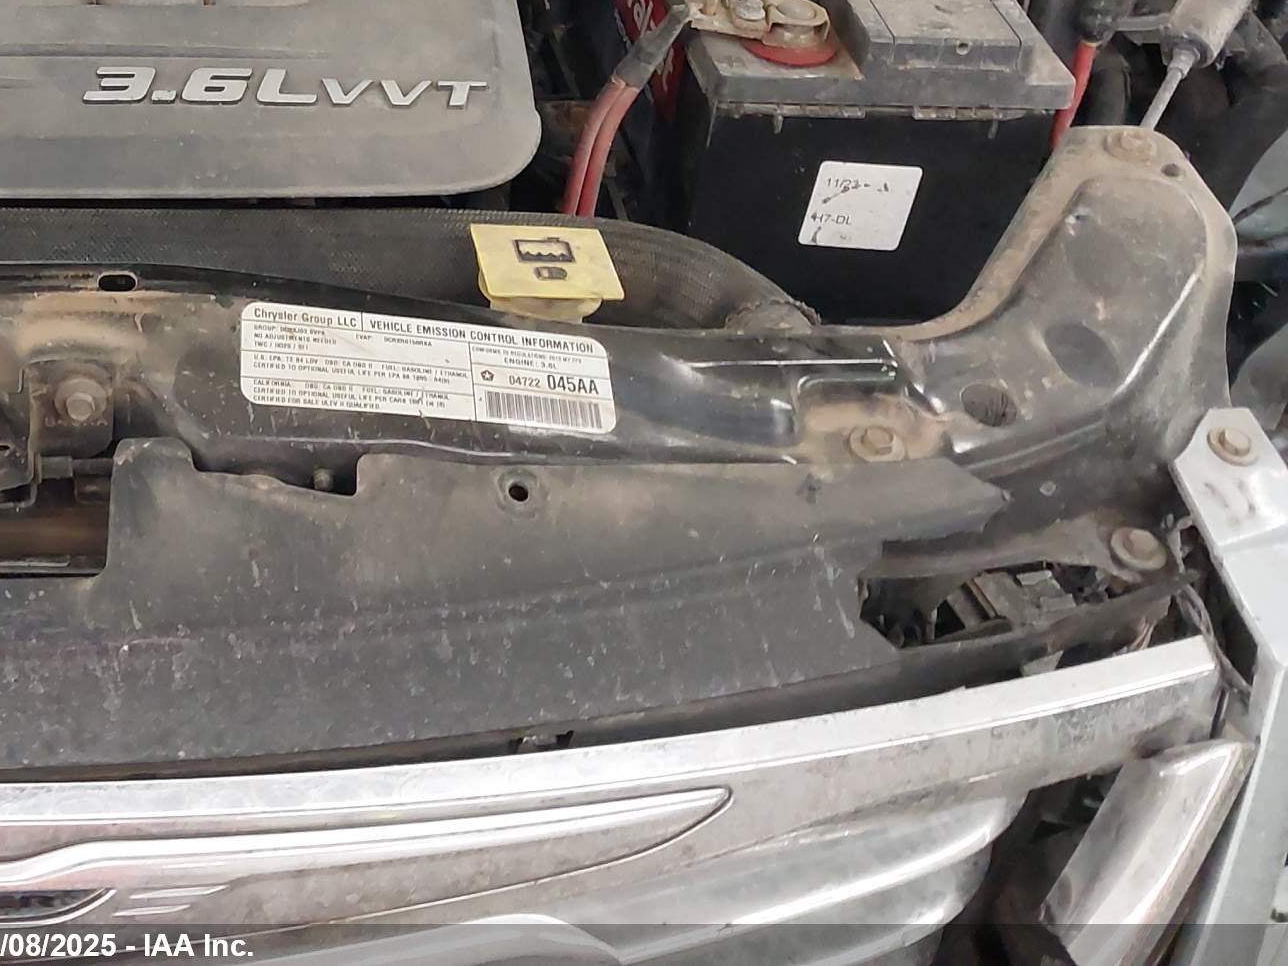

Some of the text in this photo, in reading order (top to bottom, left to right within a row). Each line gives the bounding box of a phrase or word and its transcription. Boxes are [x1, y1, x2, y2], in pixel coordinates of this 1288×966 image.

[82, 66, 489, 110] 3.6L VVT
[254, 307, 356, 327] Chrysler Group LLC
[369, 320, 593, 353] VEHICLE EMISSION CONTROL INFORMATION
[508, 374, 598, 394] 04722 045AA
